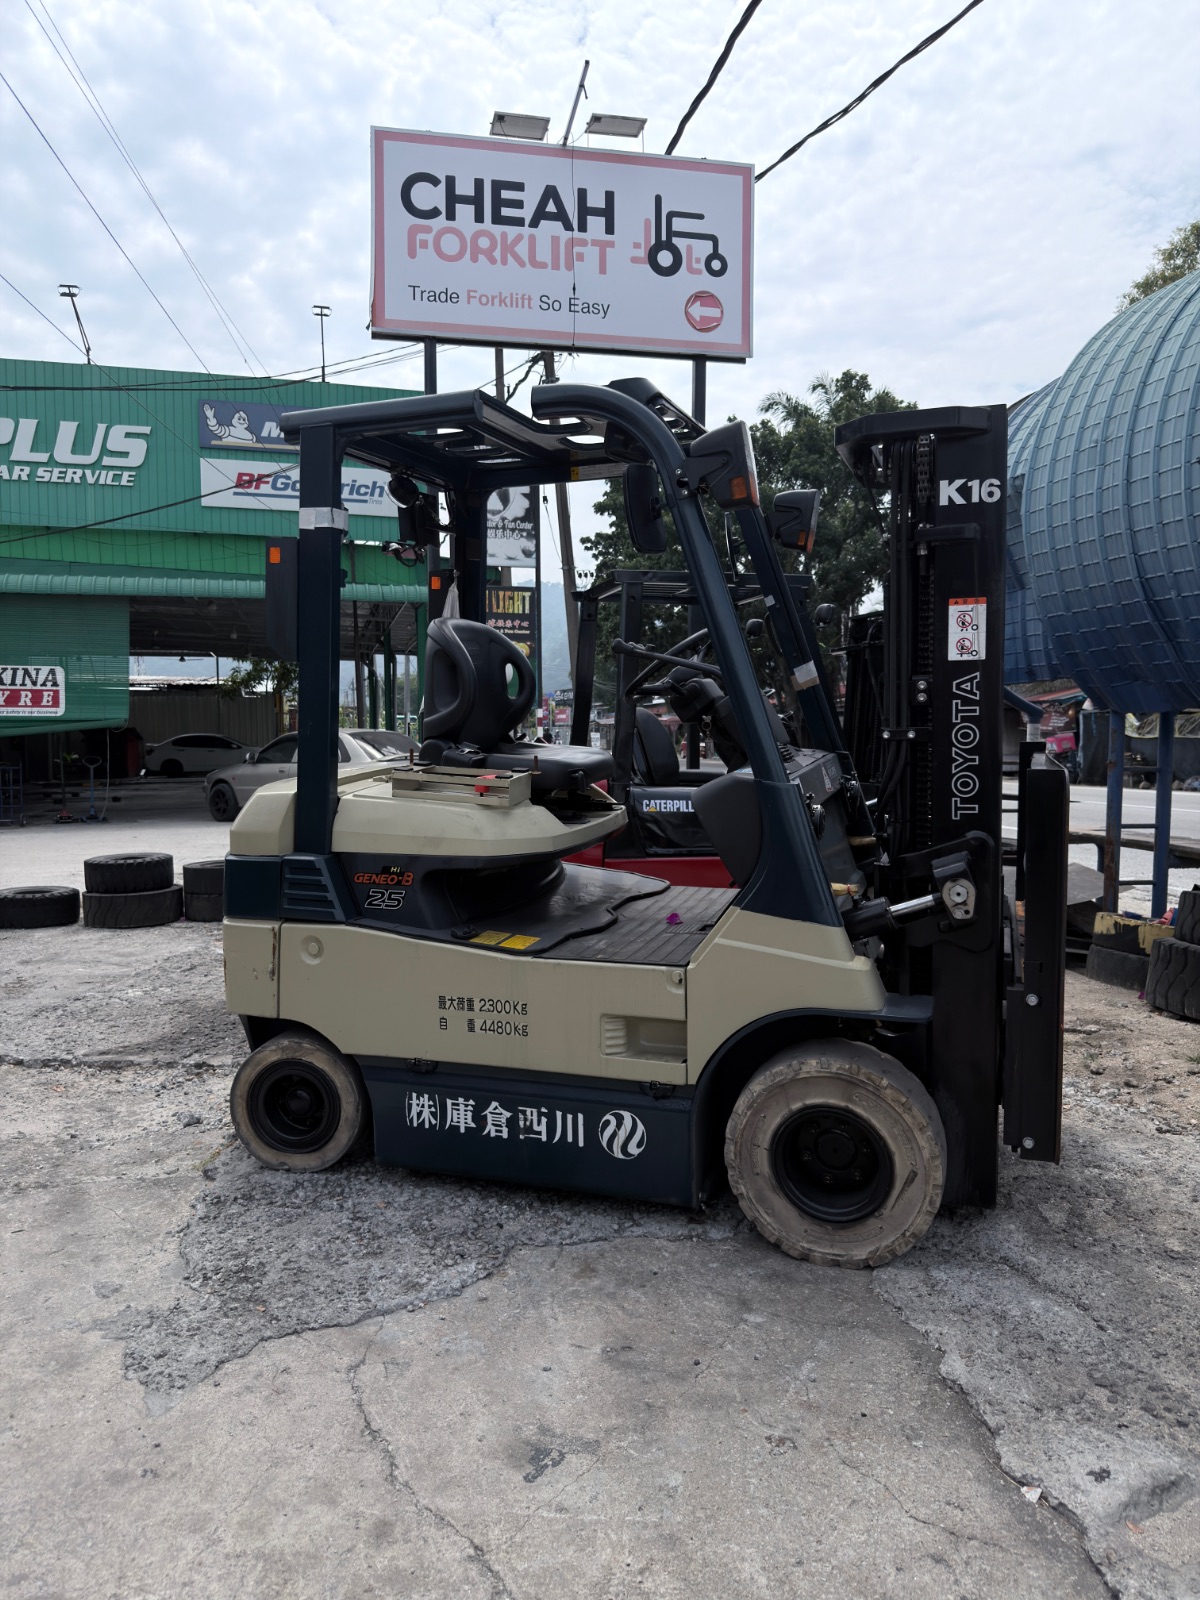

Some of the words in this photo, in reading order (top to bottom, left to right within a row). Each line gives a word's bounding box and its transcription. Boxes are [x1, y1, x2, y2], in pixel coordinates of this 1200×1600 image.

[401, 172, 615, 235] CHEAH
[407, 224, 616, 275] FORKLIFT
[408, 285, 460, 304] Trade
[466, 289, 533, 309] Forklift
[539, 295, 562, 312] So
[568, 297, 610, 319] Easy
[35, 467, 136, 486] SERVICE
[939, 478, 1002, 506] K16
[492, 590, 531, 614] LIGHT
[951, 672, 980, 820] TOYOTA
[643, 800, 694, 812] CATERPILL
[365, 889, 405, 910] 25
[438, 996, 475, 1011] 最大荷重
[479, 998, 528, 1015] 2300Kg
[480, 1020, 529, 1037] 4480Kg
